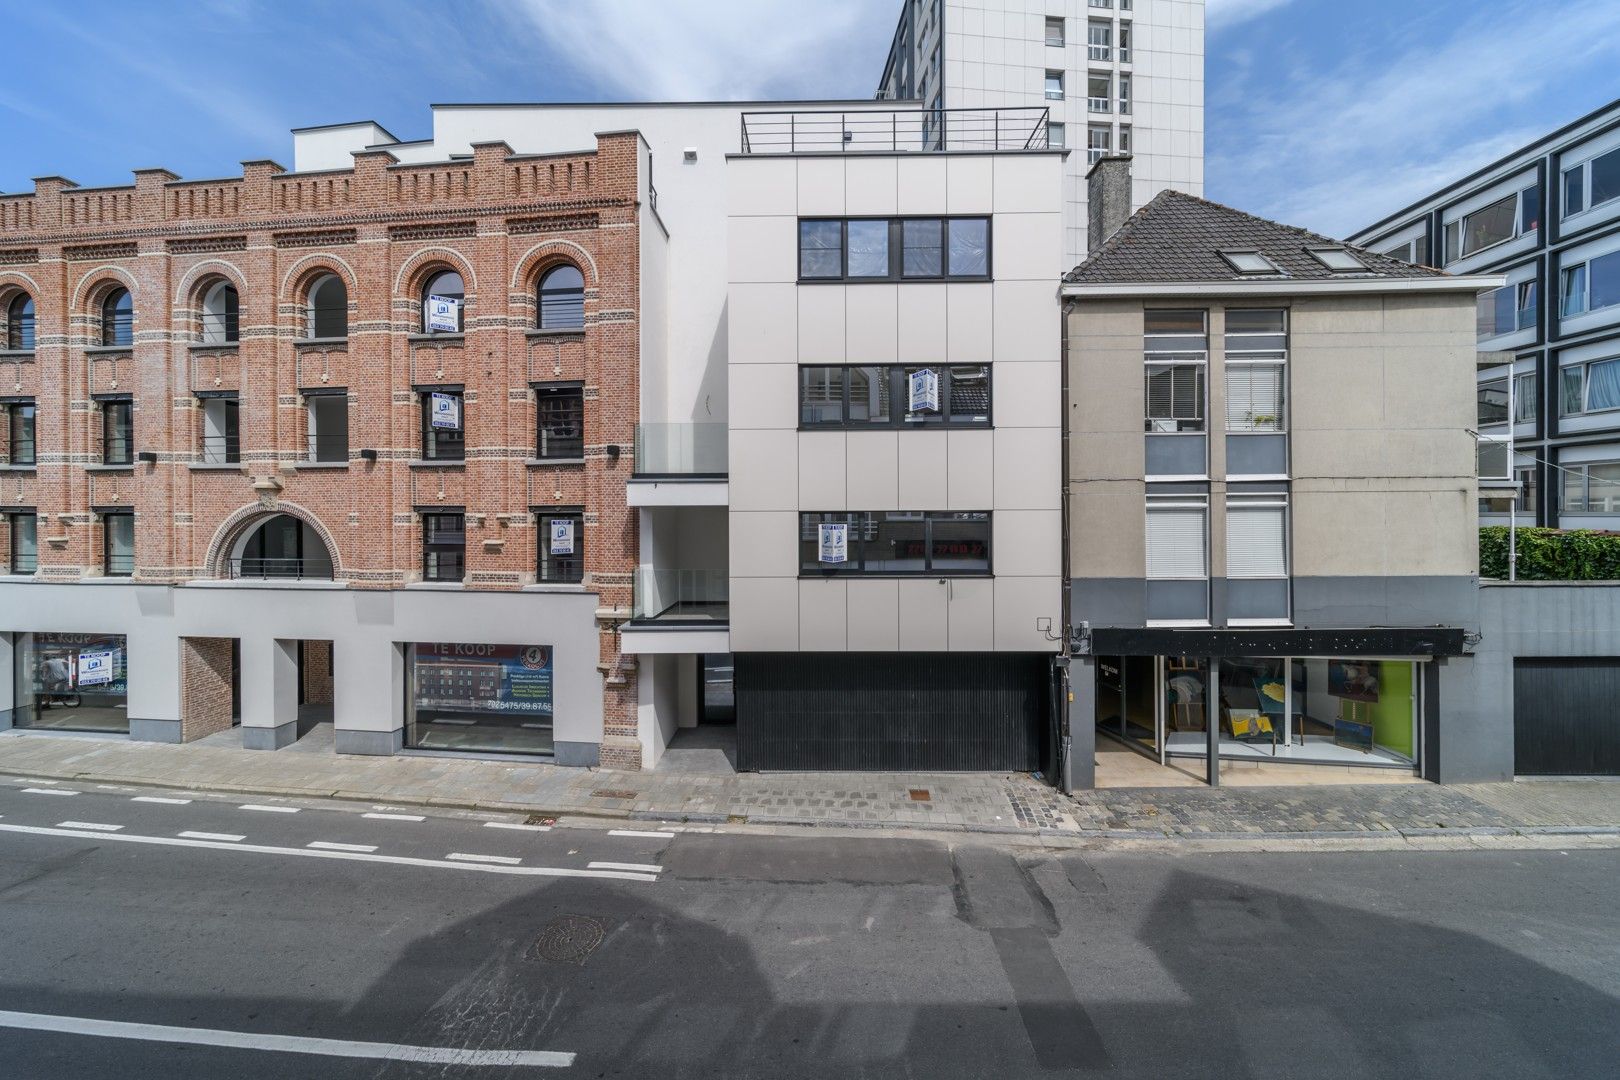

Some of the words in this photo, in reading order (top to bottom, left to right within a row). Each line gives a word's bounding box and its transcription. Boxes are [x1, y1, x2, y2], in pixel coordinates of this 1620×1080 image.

[58, 633, 92, 644] KOOP
[433, 643, 449, 655] TE
[455, 643, 496, 656] KOOP
[528, 649, 538, 662] 4
